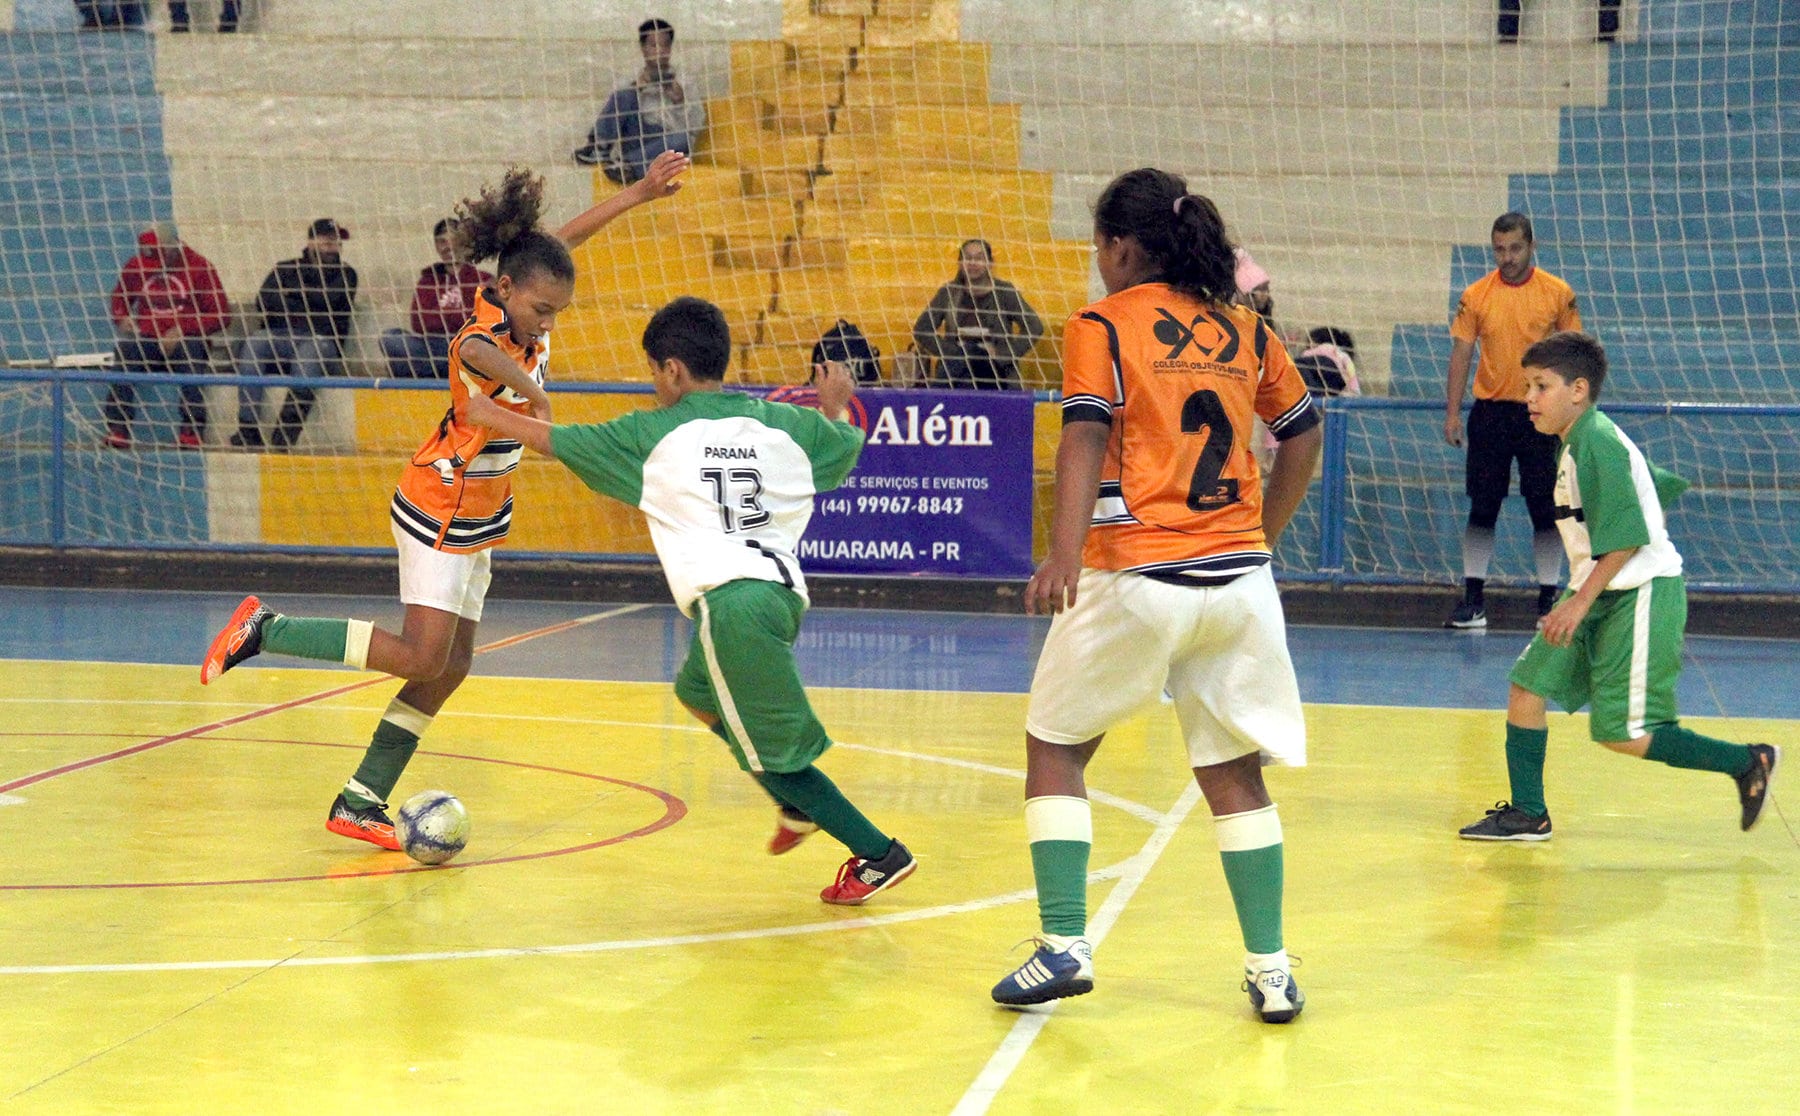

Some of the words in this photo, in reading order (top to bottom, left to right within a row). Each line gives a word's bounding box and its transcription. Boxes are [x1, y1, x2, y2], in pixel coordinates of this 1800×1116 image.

[867, 403, 993, 446] Além
[704, 445, 758, 460] PARANÁ
[1181, 389, 1240, 512] 2
[860, 476, 918, 491] SERVIÇOS
[921, 477, 930, 489] E
[933, 477, 989, 489] EVENTOS
[700, 467, 770, 534] 13
[821, 499, 851, 516] (44)
[794, 540, 914, 559] MUARAMA
[932, 542, 960, 560] PR
